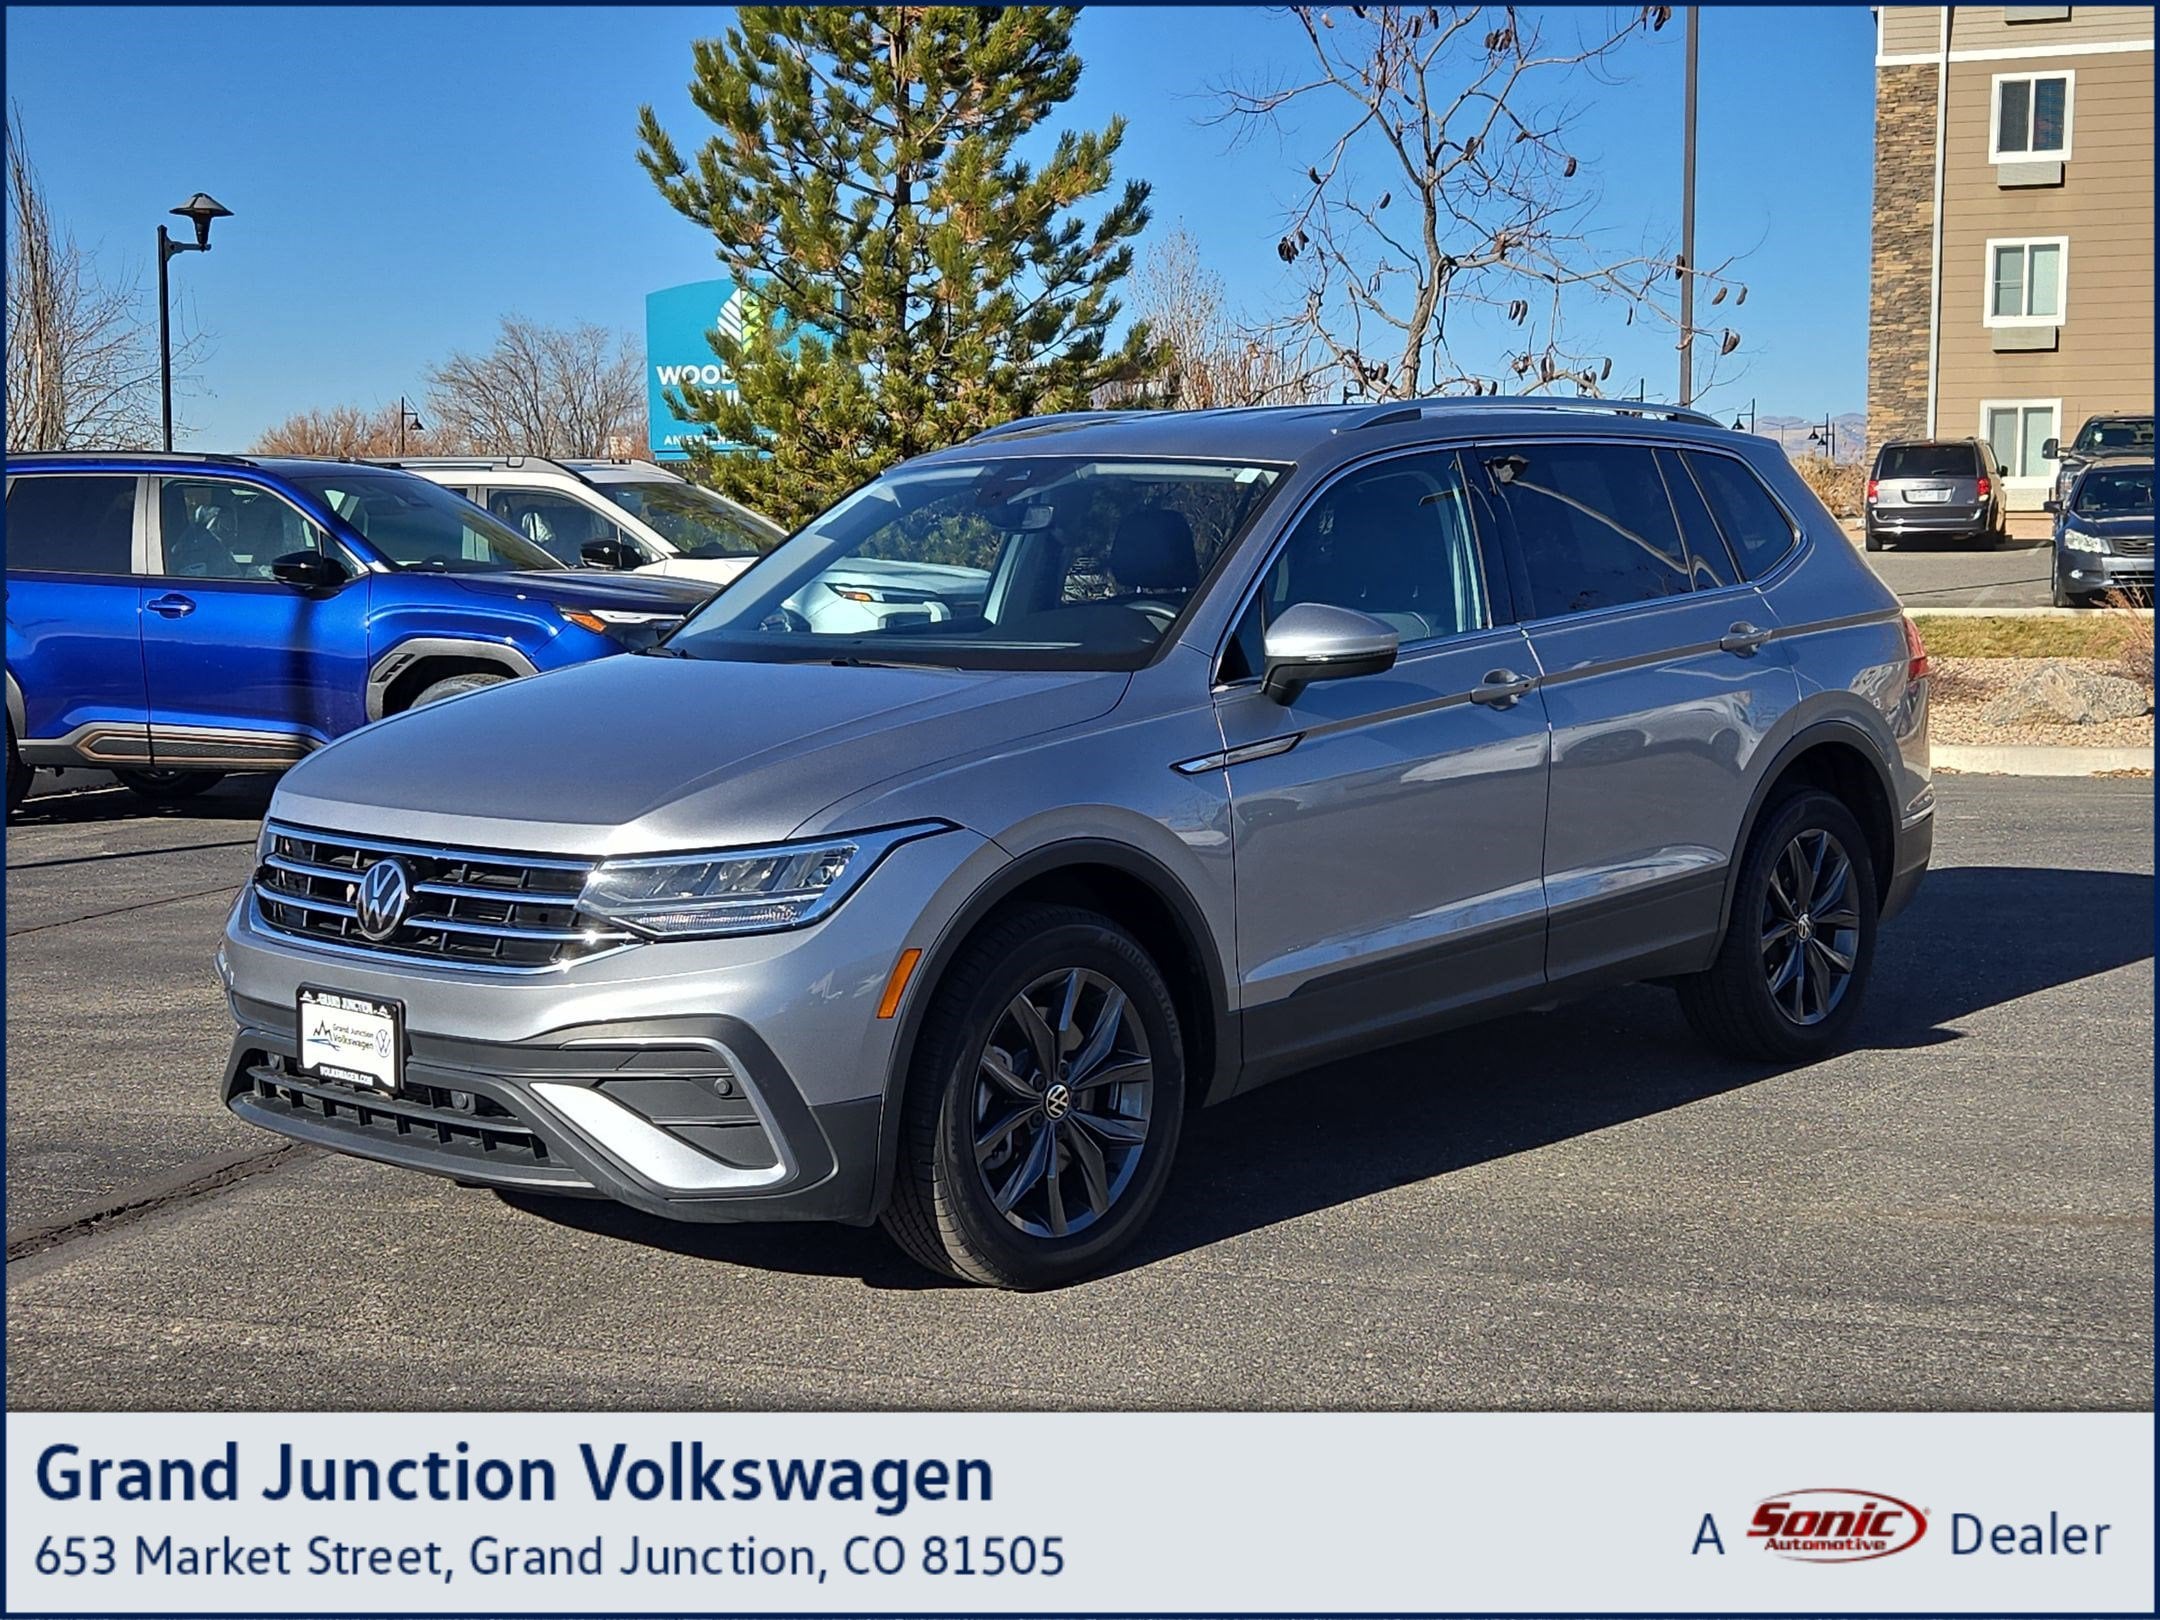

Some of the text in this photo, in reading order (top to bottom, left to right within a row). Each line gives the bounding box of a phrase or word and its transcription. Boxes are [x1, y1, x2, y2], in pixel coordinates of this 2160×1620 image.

[656, 364, 750, 386] WOOD
[332, 1023, 374, 1039] Grand Junction
[333, 1033, 375, 1051] Volkswagen
